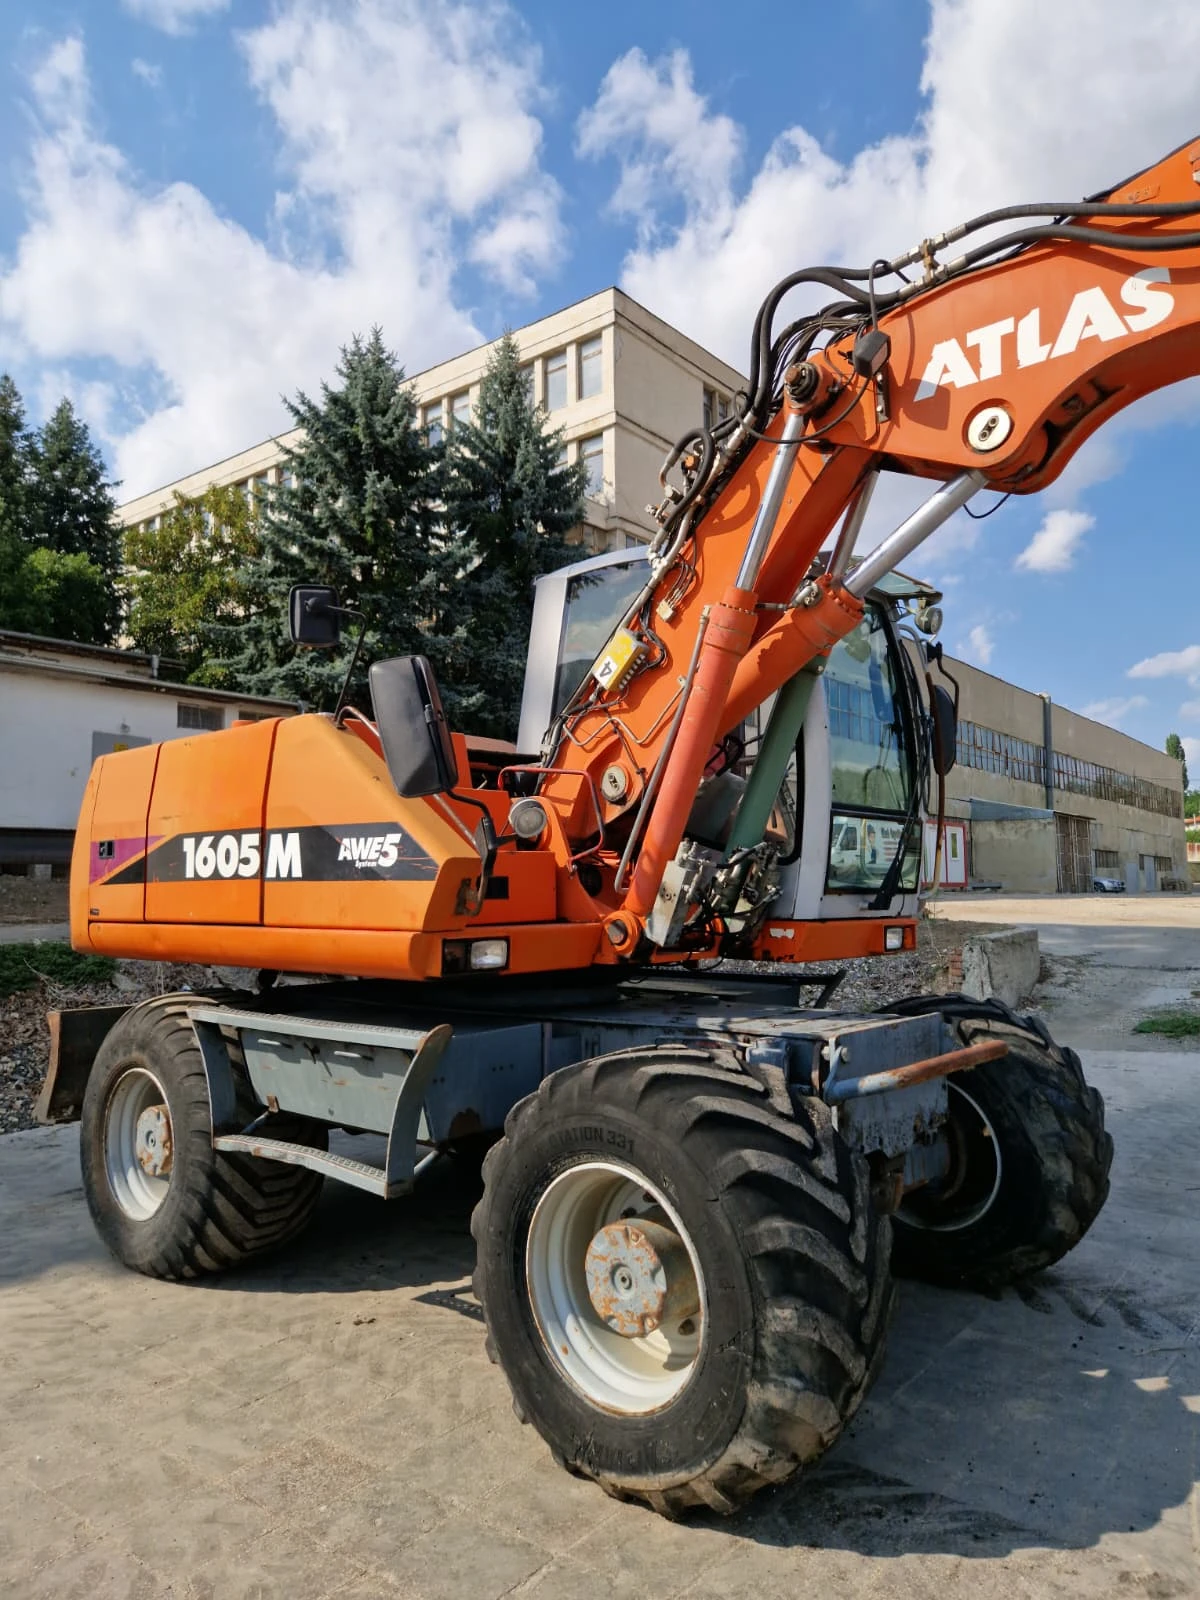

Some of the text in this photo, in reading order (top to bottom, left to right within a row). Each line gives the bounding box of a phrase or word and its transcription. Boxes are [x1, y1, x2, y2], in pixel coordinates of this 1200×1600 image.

[913, 266, 1175, 402] ATLAS
[600, 661, 613, 677] 4
[607, 1130, 635, 1153] 331
